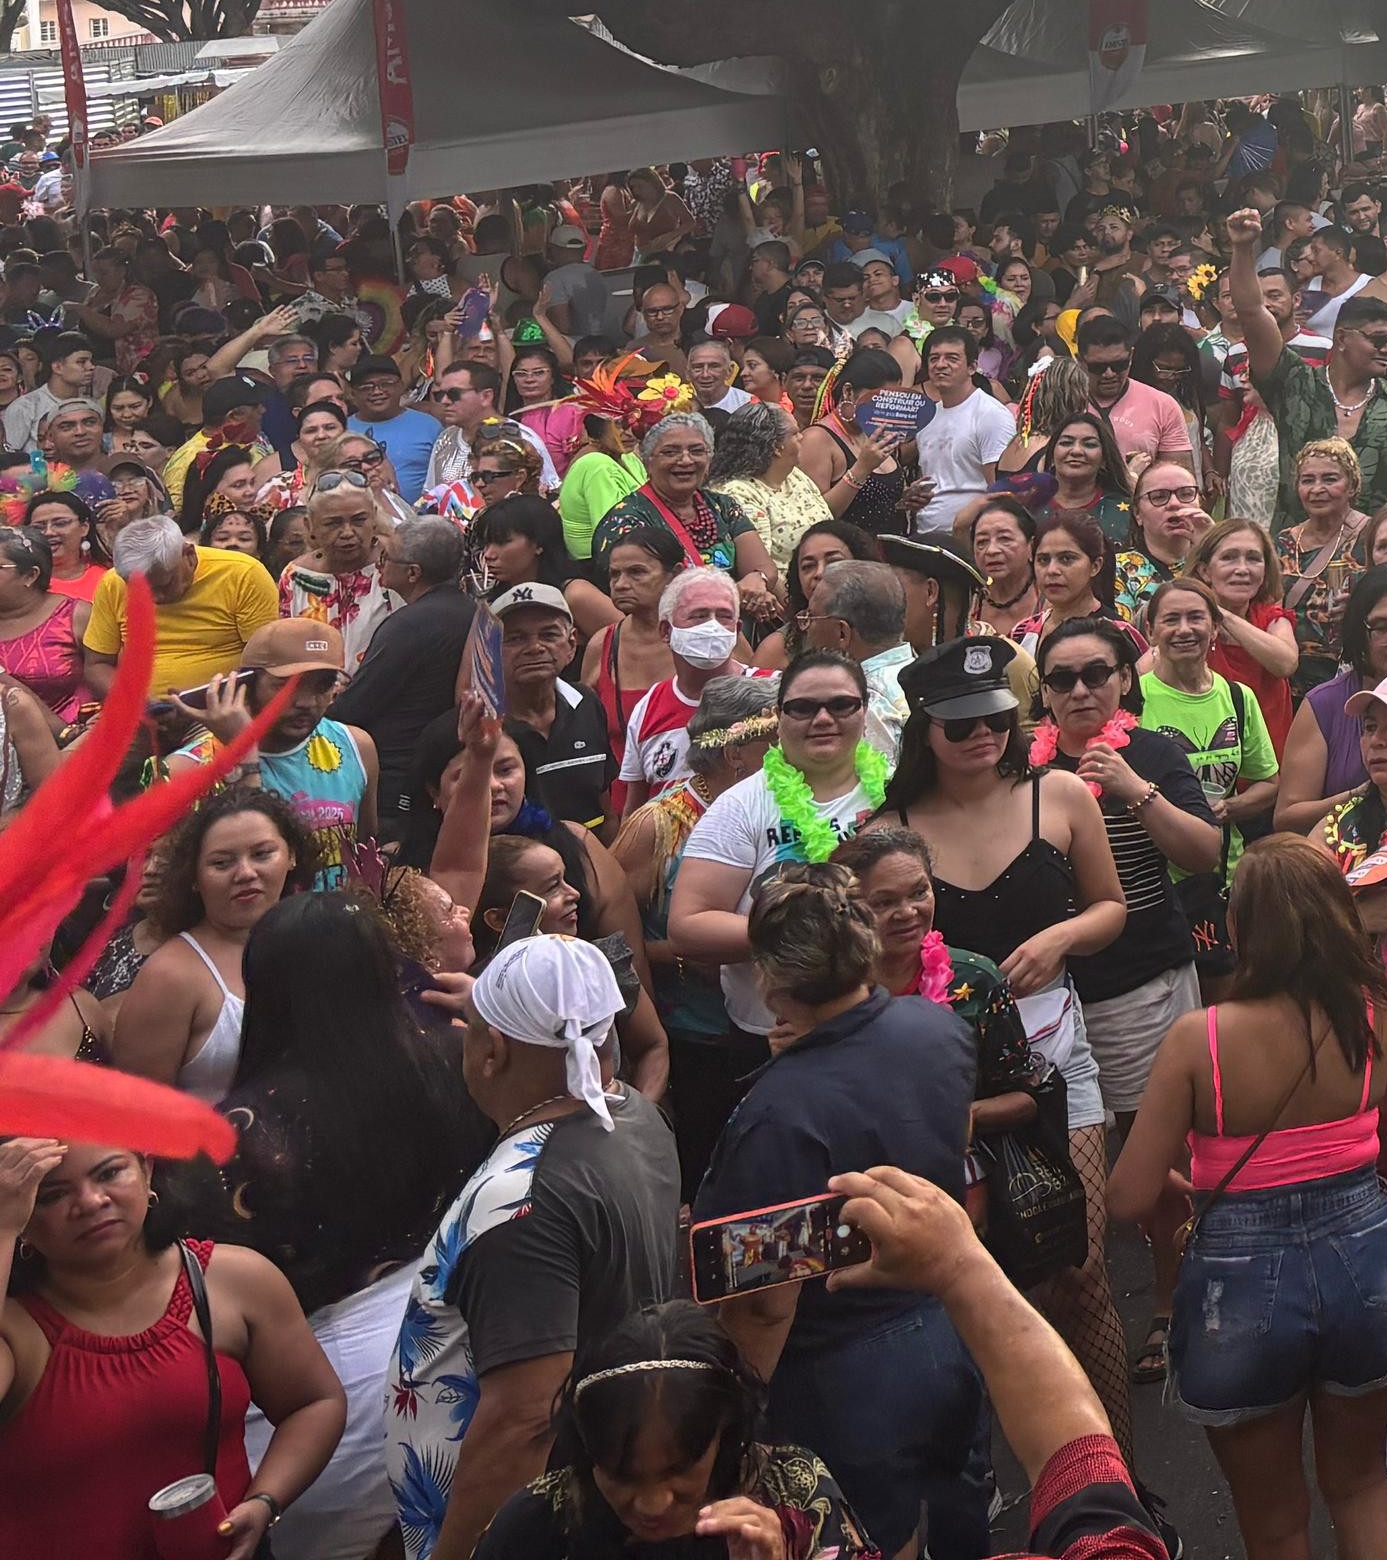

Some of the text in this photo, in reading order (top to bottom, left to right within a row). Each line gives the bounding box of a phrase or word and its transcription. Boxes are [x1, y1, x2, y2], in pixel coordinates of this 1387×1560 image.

[871, 394, 914, 406] CONSTRUIR
[879, 389, 909, 399] PENSOU
[512, 586, 534, 602] NY
[1191, 919, 1220, 953] NY
